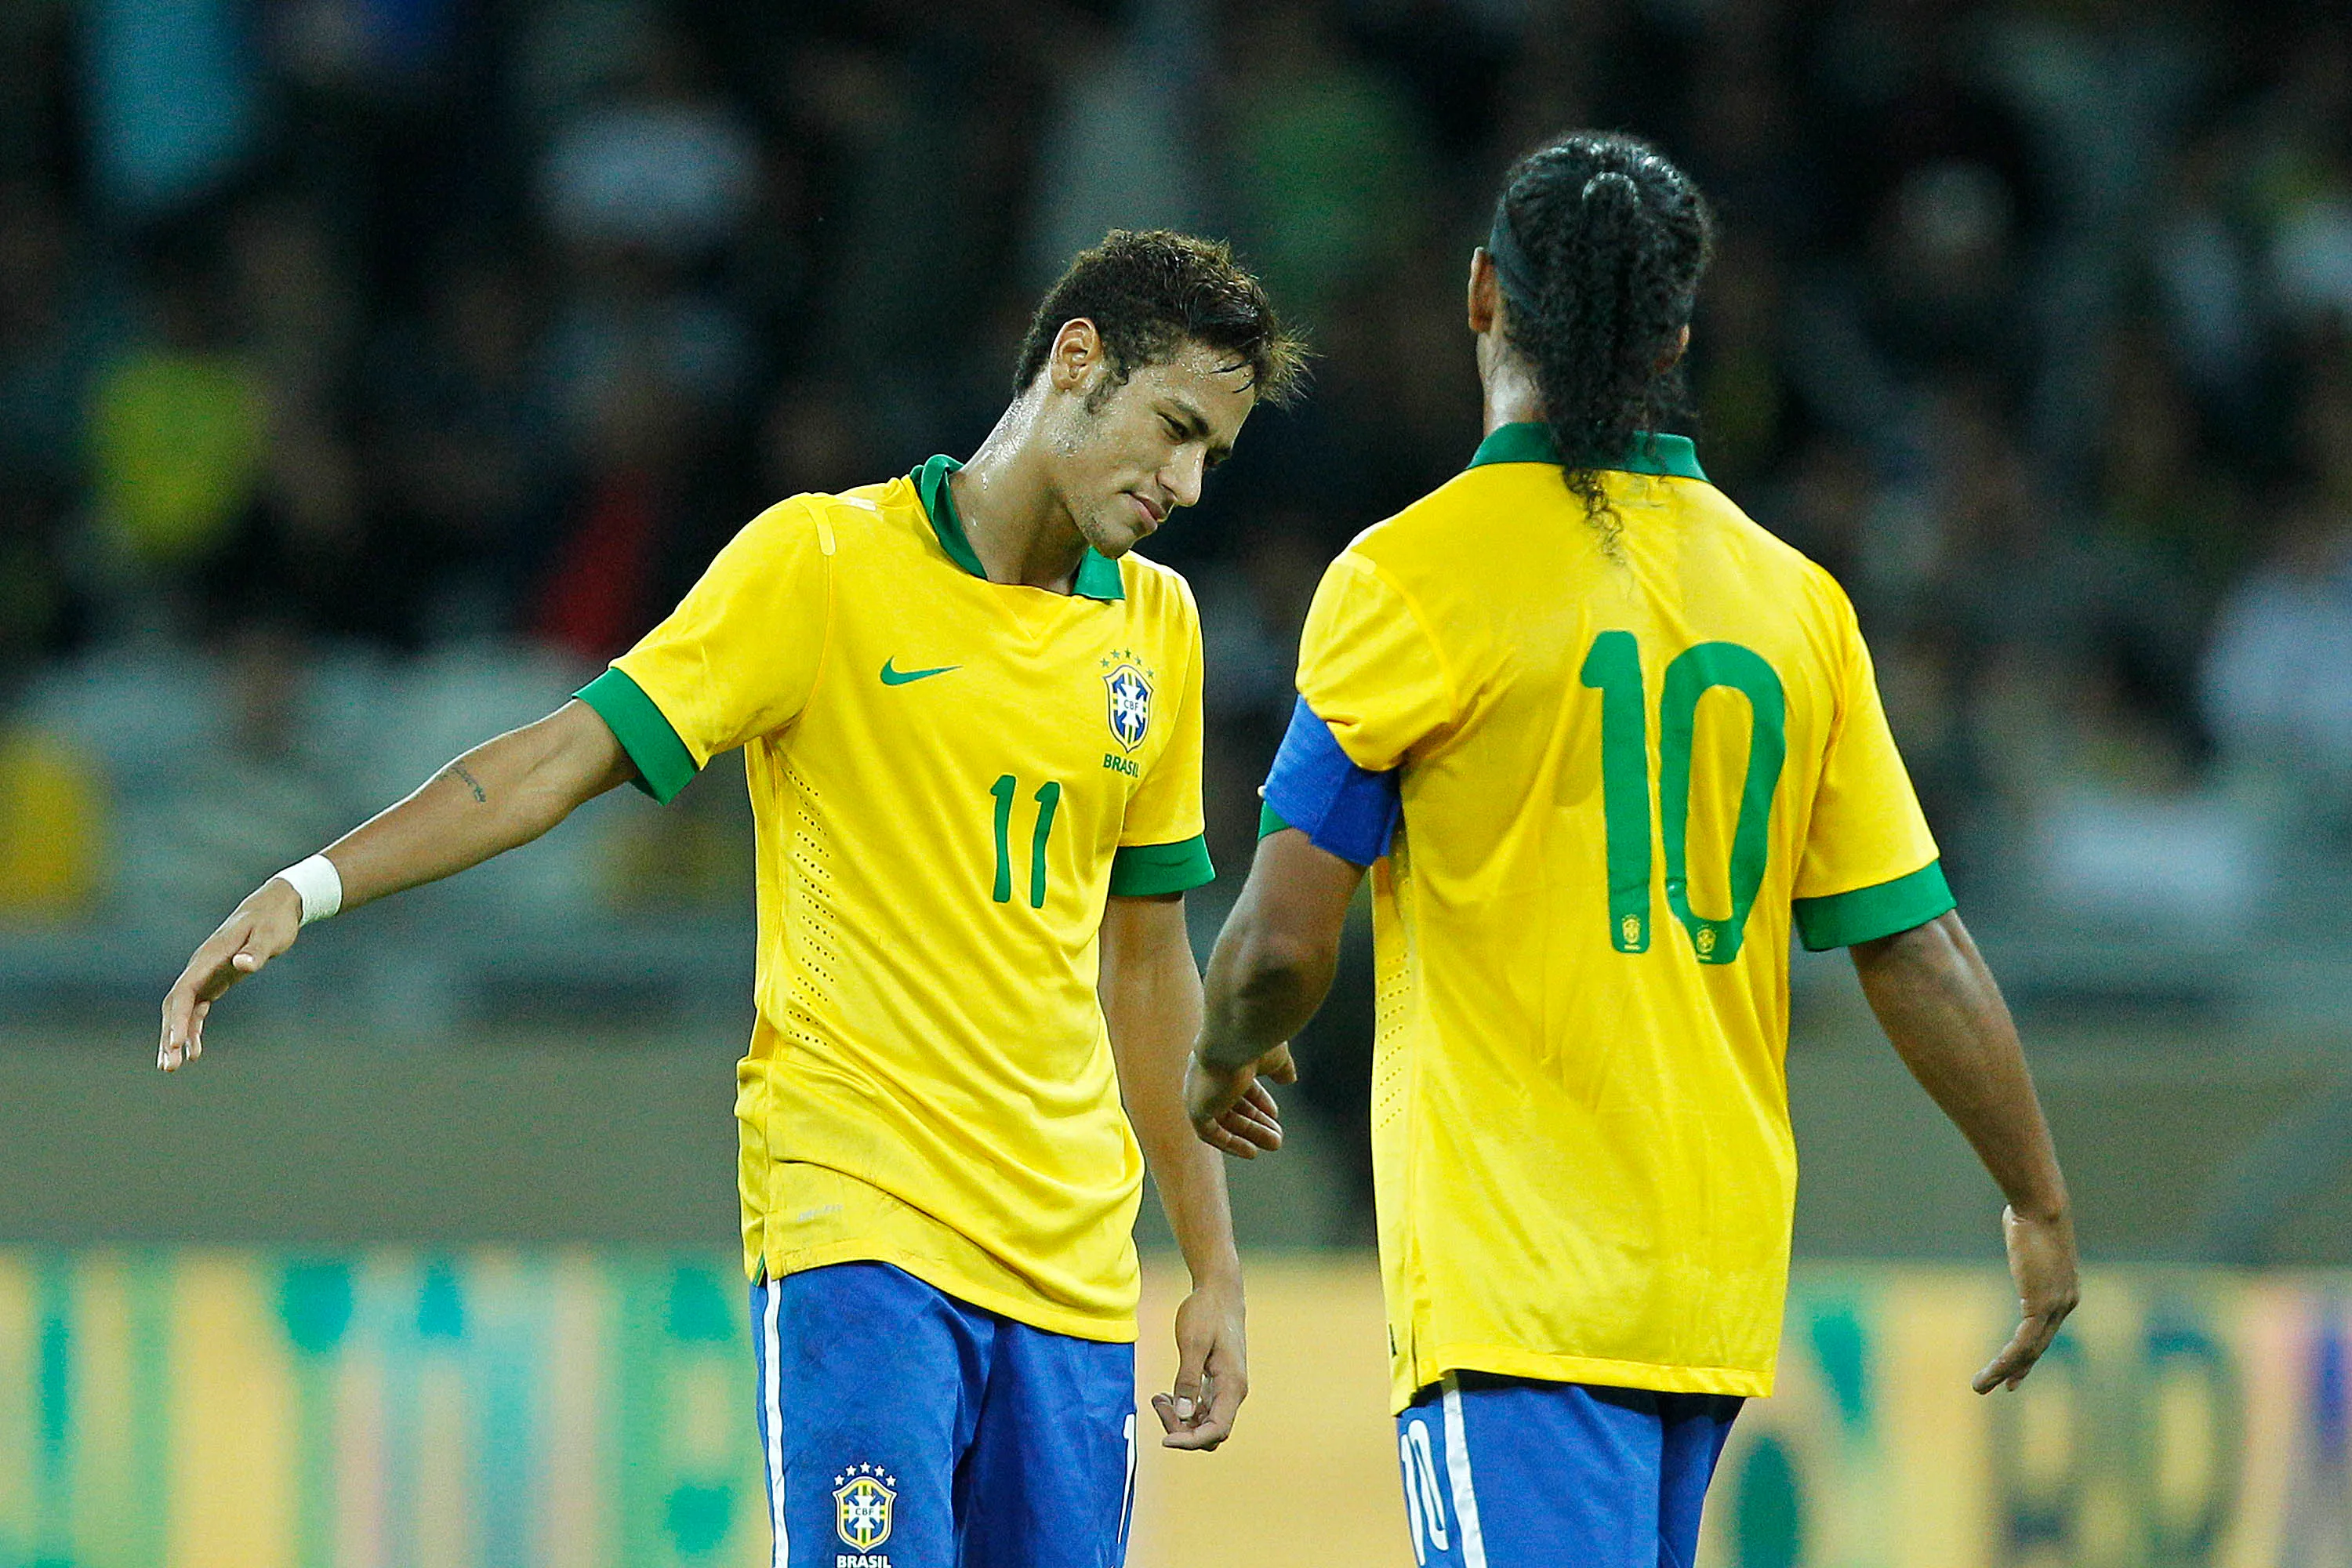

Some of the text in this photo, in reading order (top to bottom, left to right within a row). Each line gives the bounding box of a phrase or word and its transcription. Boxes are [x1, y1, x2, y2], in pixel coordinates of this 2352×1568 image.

[1123, 699, 1139, 710] CBF
[1103, 753, 1139, 778] BRASIL
[1580, 630, 1786, 964] 10
[990, 775, 1061, 909] 11
[1400, 1419, 1449, 1566] 10
[837, 1555, 891, 1568] BRASIL
